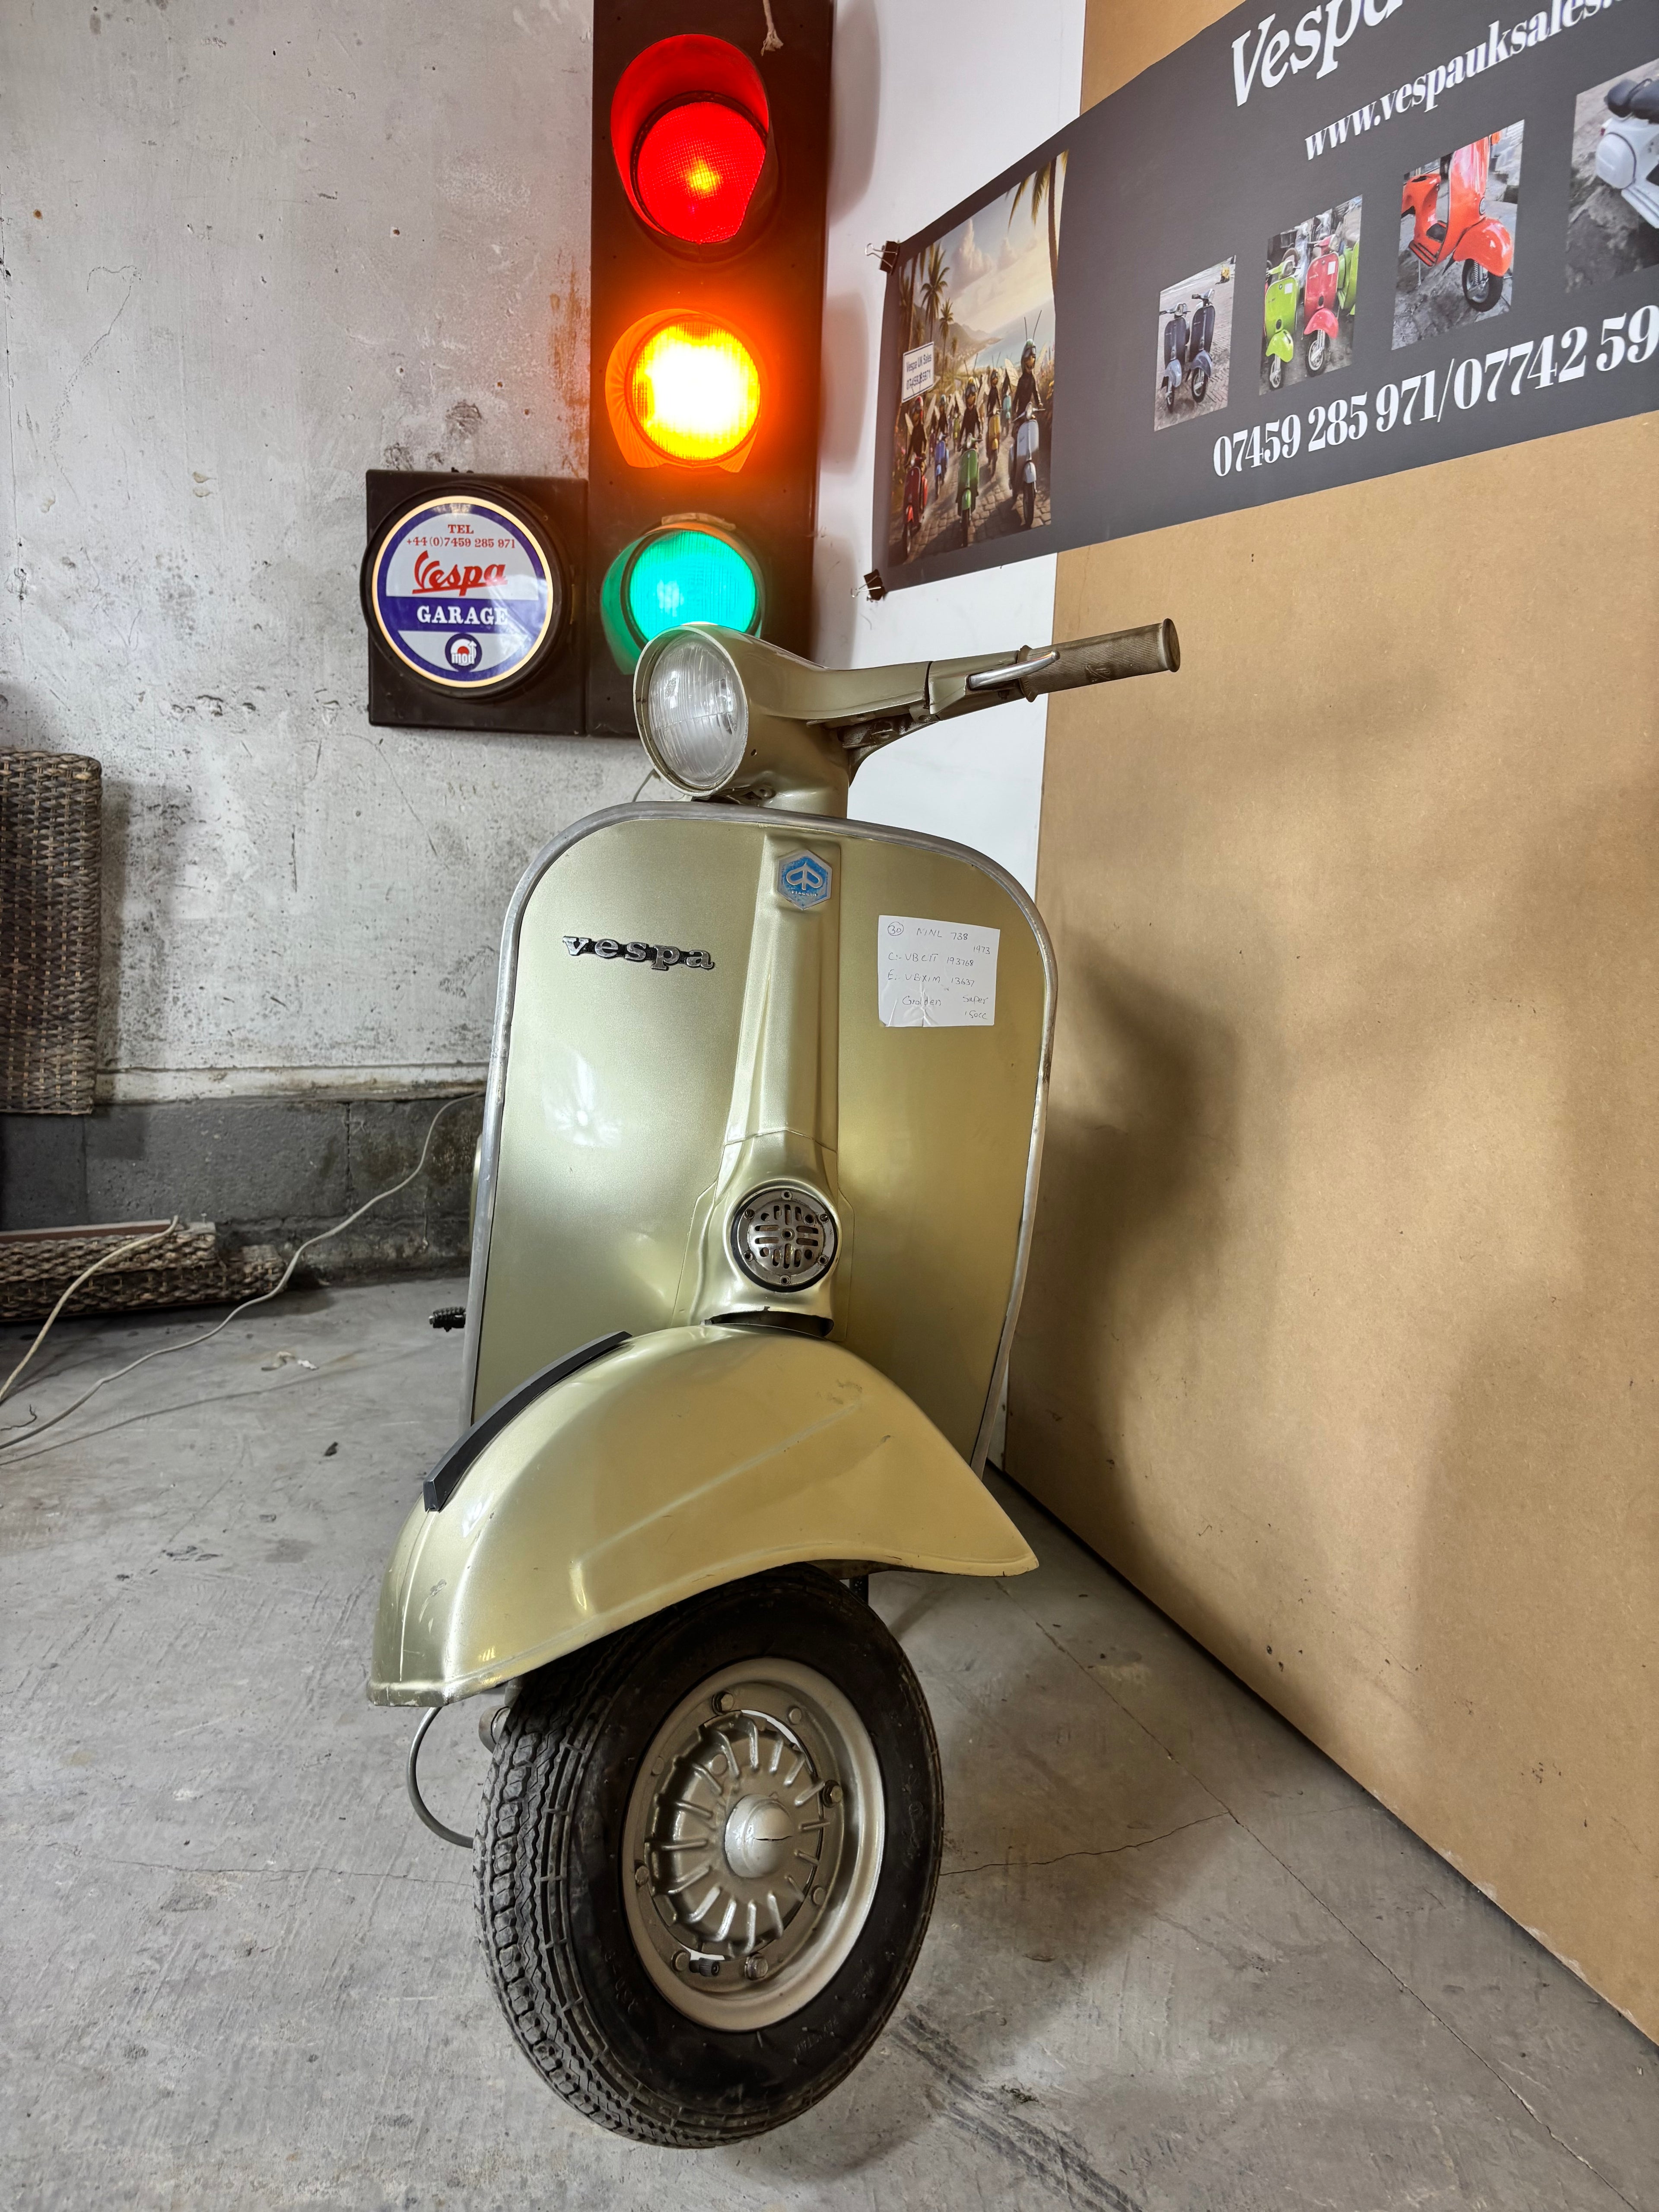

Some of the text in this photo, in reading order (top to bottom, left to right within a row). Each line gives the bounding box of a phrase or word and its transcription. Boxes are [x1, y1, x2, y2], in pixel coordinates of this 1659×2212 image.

[1213, 305, 1659, 477] 07459 285 971/07742 59
[448, 524, 474, 534] TEL
[474, 539, 494, 547] 285
[498, 539, 515, 548] 971
[412, 550, 508, 597] Vespa
[417, 606, 508, 625] GARAGE
[451, 641, 477, 664] mod
[563, 935, 715, 971] vespa
[973, 945, 990, 954] 1973
[902, 995, 989, 1006] Golden Super
